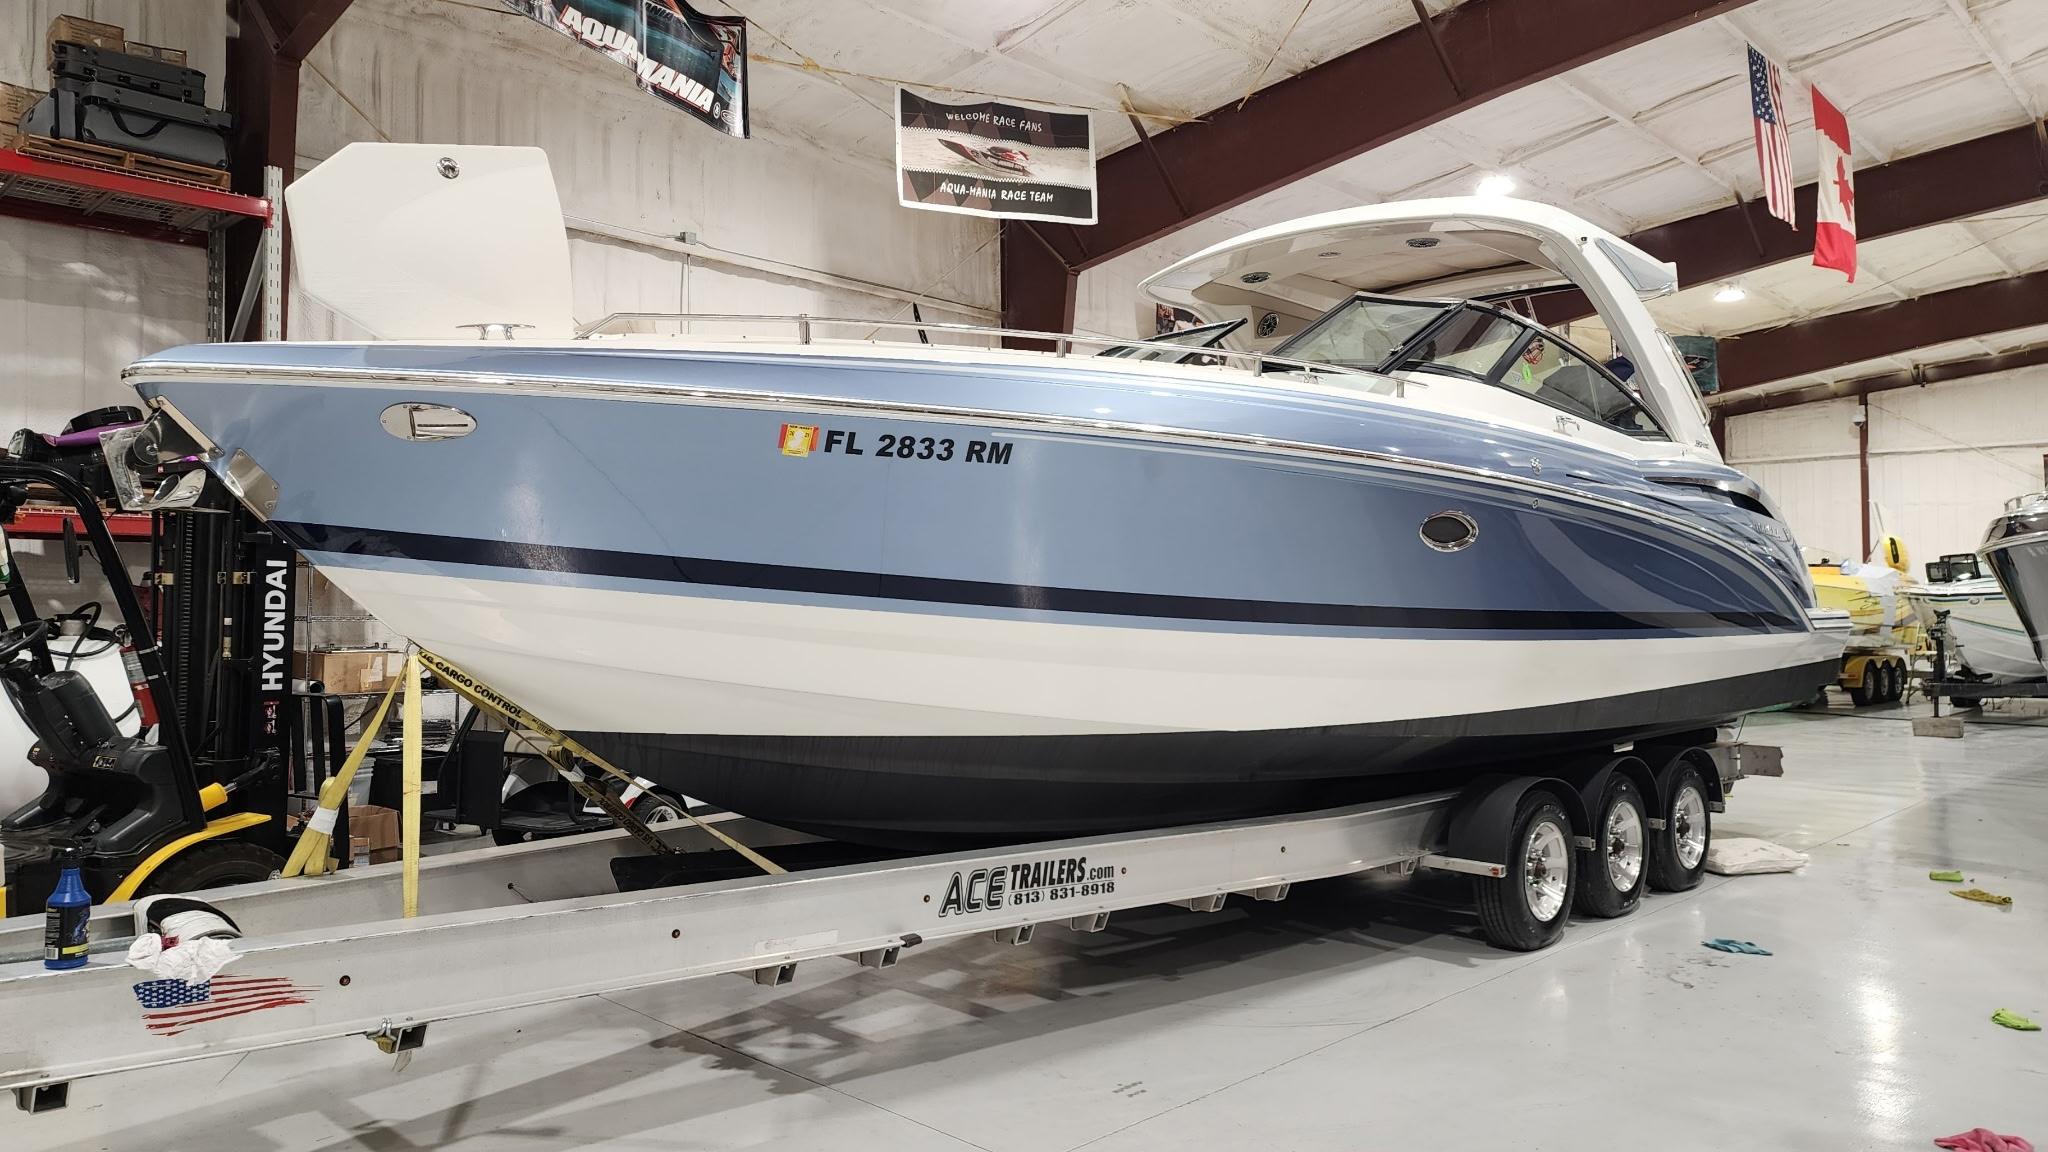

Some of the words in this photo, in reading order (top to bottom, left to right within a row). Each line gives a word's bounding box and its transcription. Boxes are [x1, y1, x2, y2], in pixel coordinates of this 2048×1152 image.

[560, 6, 639, 61] AQUA
[945, 112, 990, 124] WELCOME
[993, 116, 1016, 128] RACE
[1019, 120, 1043, 132] FANS
[939, 181, 997, 200] AQUA-MANIA
[1001, 190, 1027, 201] RACE
[1030, 191, 1054, 203] TEAM
[824, 430, 863, 455] FL
[875, 434, 955, 461] 2833
[965, 440, 1014, 465] RM
[261, 560, 288, 691] HYUNDAI
[435, 661, 473, 688] CARGO
[473, 684, 522, 719] CONTROL
[938, 866, 1008, 918] ACE
[1010, 856, 1114, 890] TRAILERS.com
[1008, 890, 1045, 906] (813)
[1049, 881, 1115, 901] 831-8918
